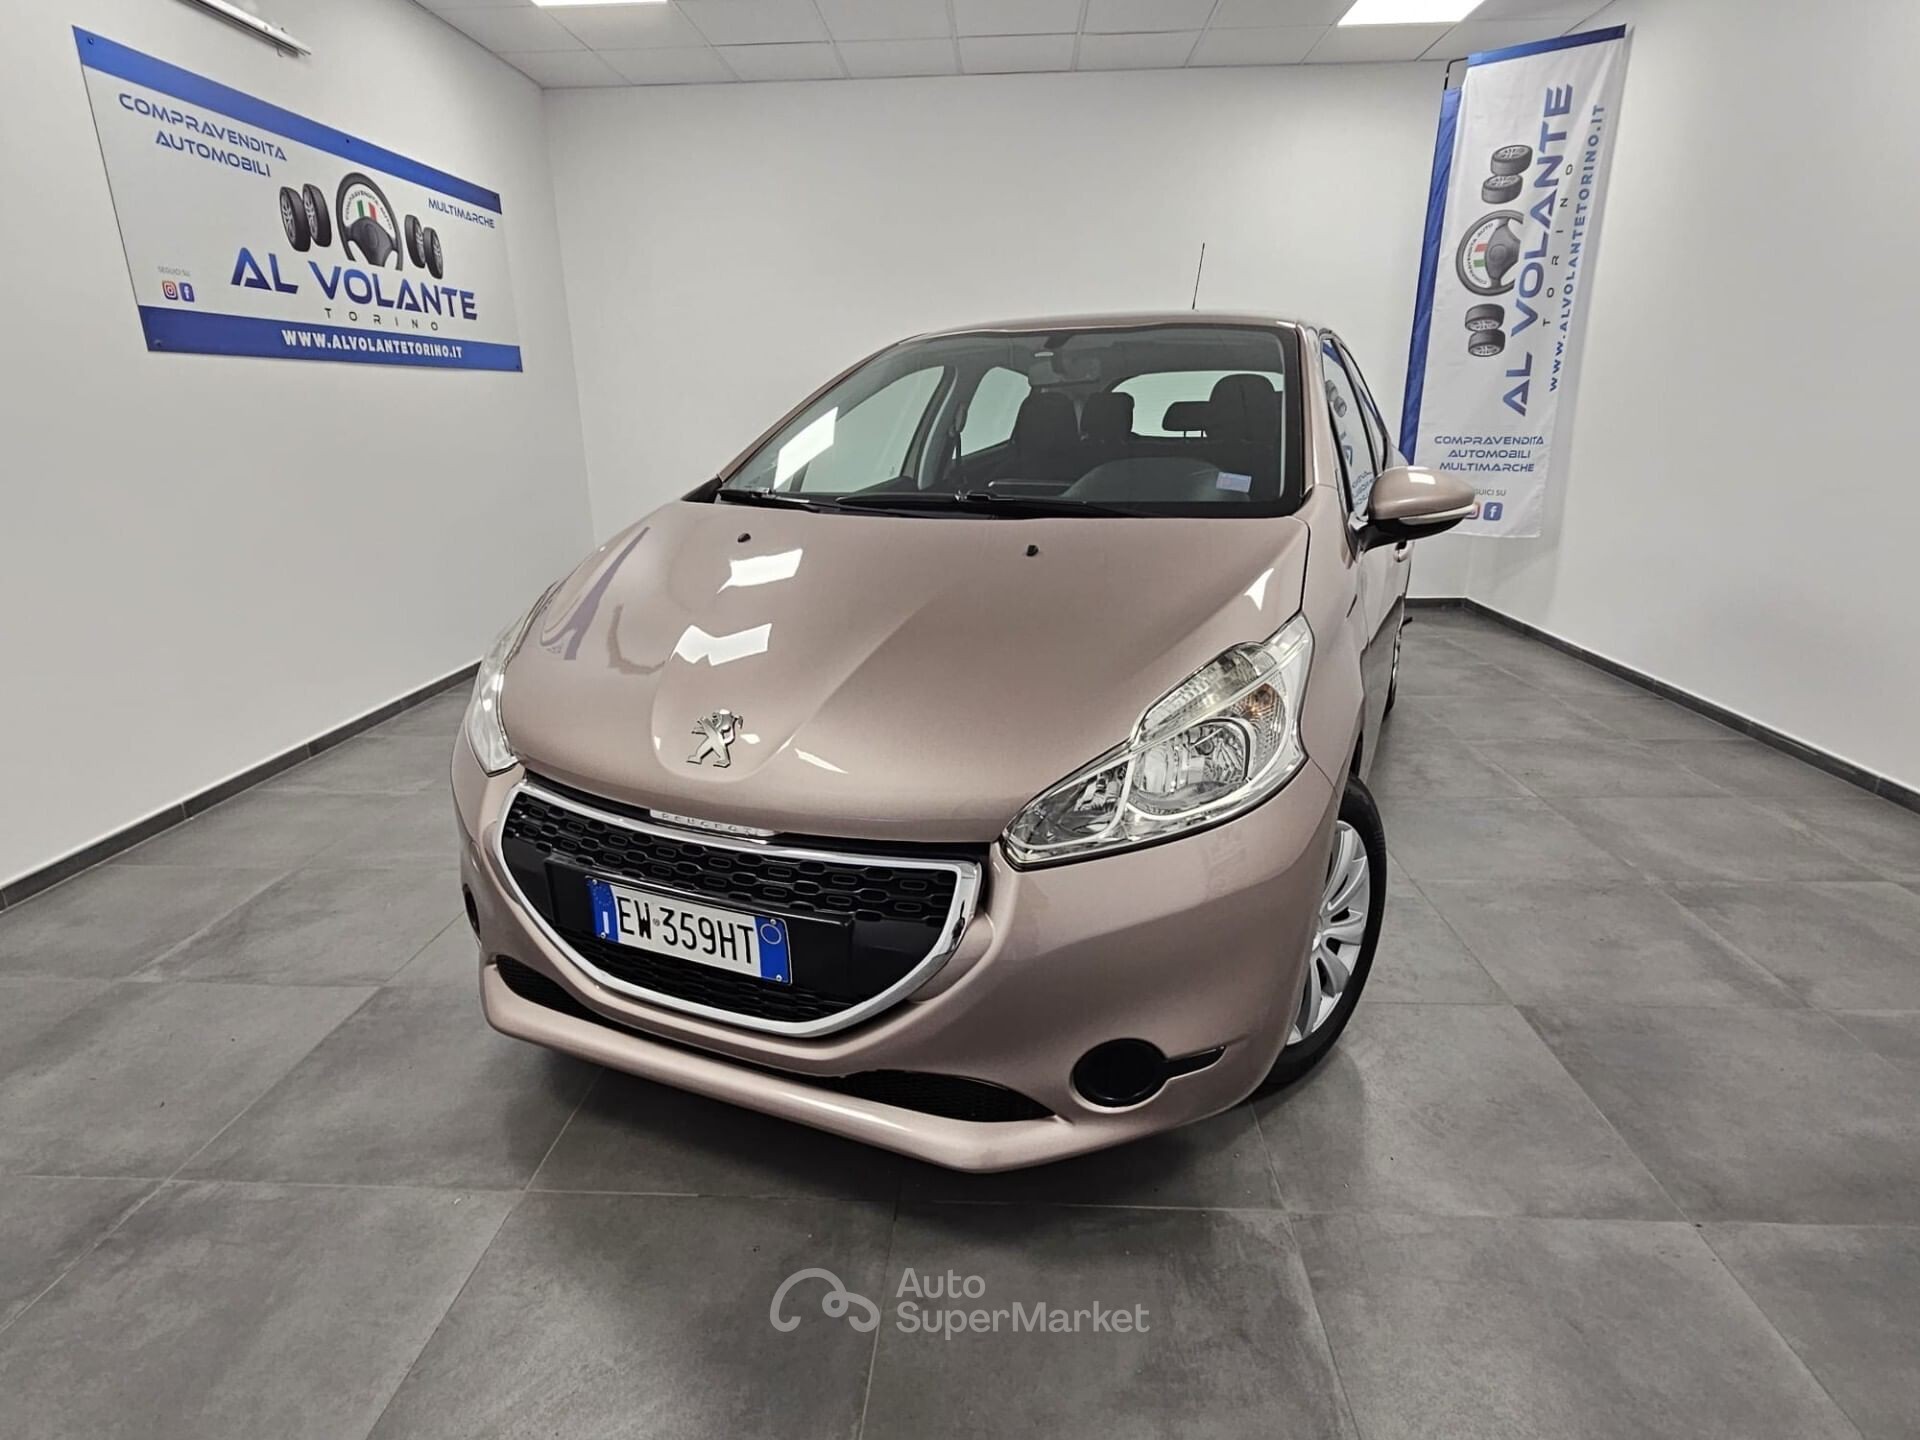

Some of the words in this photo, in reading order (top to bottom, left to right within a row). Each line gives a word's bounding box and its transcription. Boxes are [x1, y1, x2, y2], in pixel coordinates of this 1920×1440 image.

[118, 93, 288, 162] COMPRAVENDITA
[155, 130, 272, 178] AUTOMOBILI
[428, 197, 496, 229] MULTIMARCHE
[1510, 83, 1574, 337] VOLANTE
[1542, 163, 1574, 327] TORINO
[1548, 103, 1605, 392] WWW.ALVOLANTETORINO.IT
[230, 247, 299, 295] AL
[307, 259, 478, 321] VOLANTE
[323, 307, 439, 331] TORINO
[281, 329, 463, 359] WWW.ALVOLANTETORINO.IT
[1502, 351, 1533, 417] AL
[1434, 435, 1544, 446] COMPRAVENDITA
[1448, 449, 1532, 459] AUTOMOBILI
[1439, 462, 1535, 473] MULTIMARCHE
